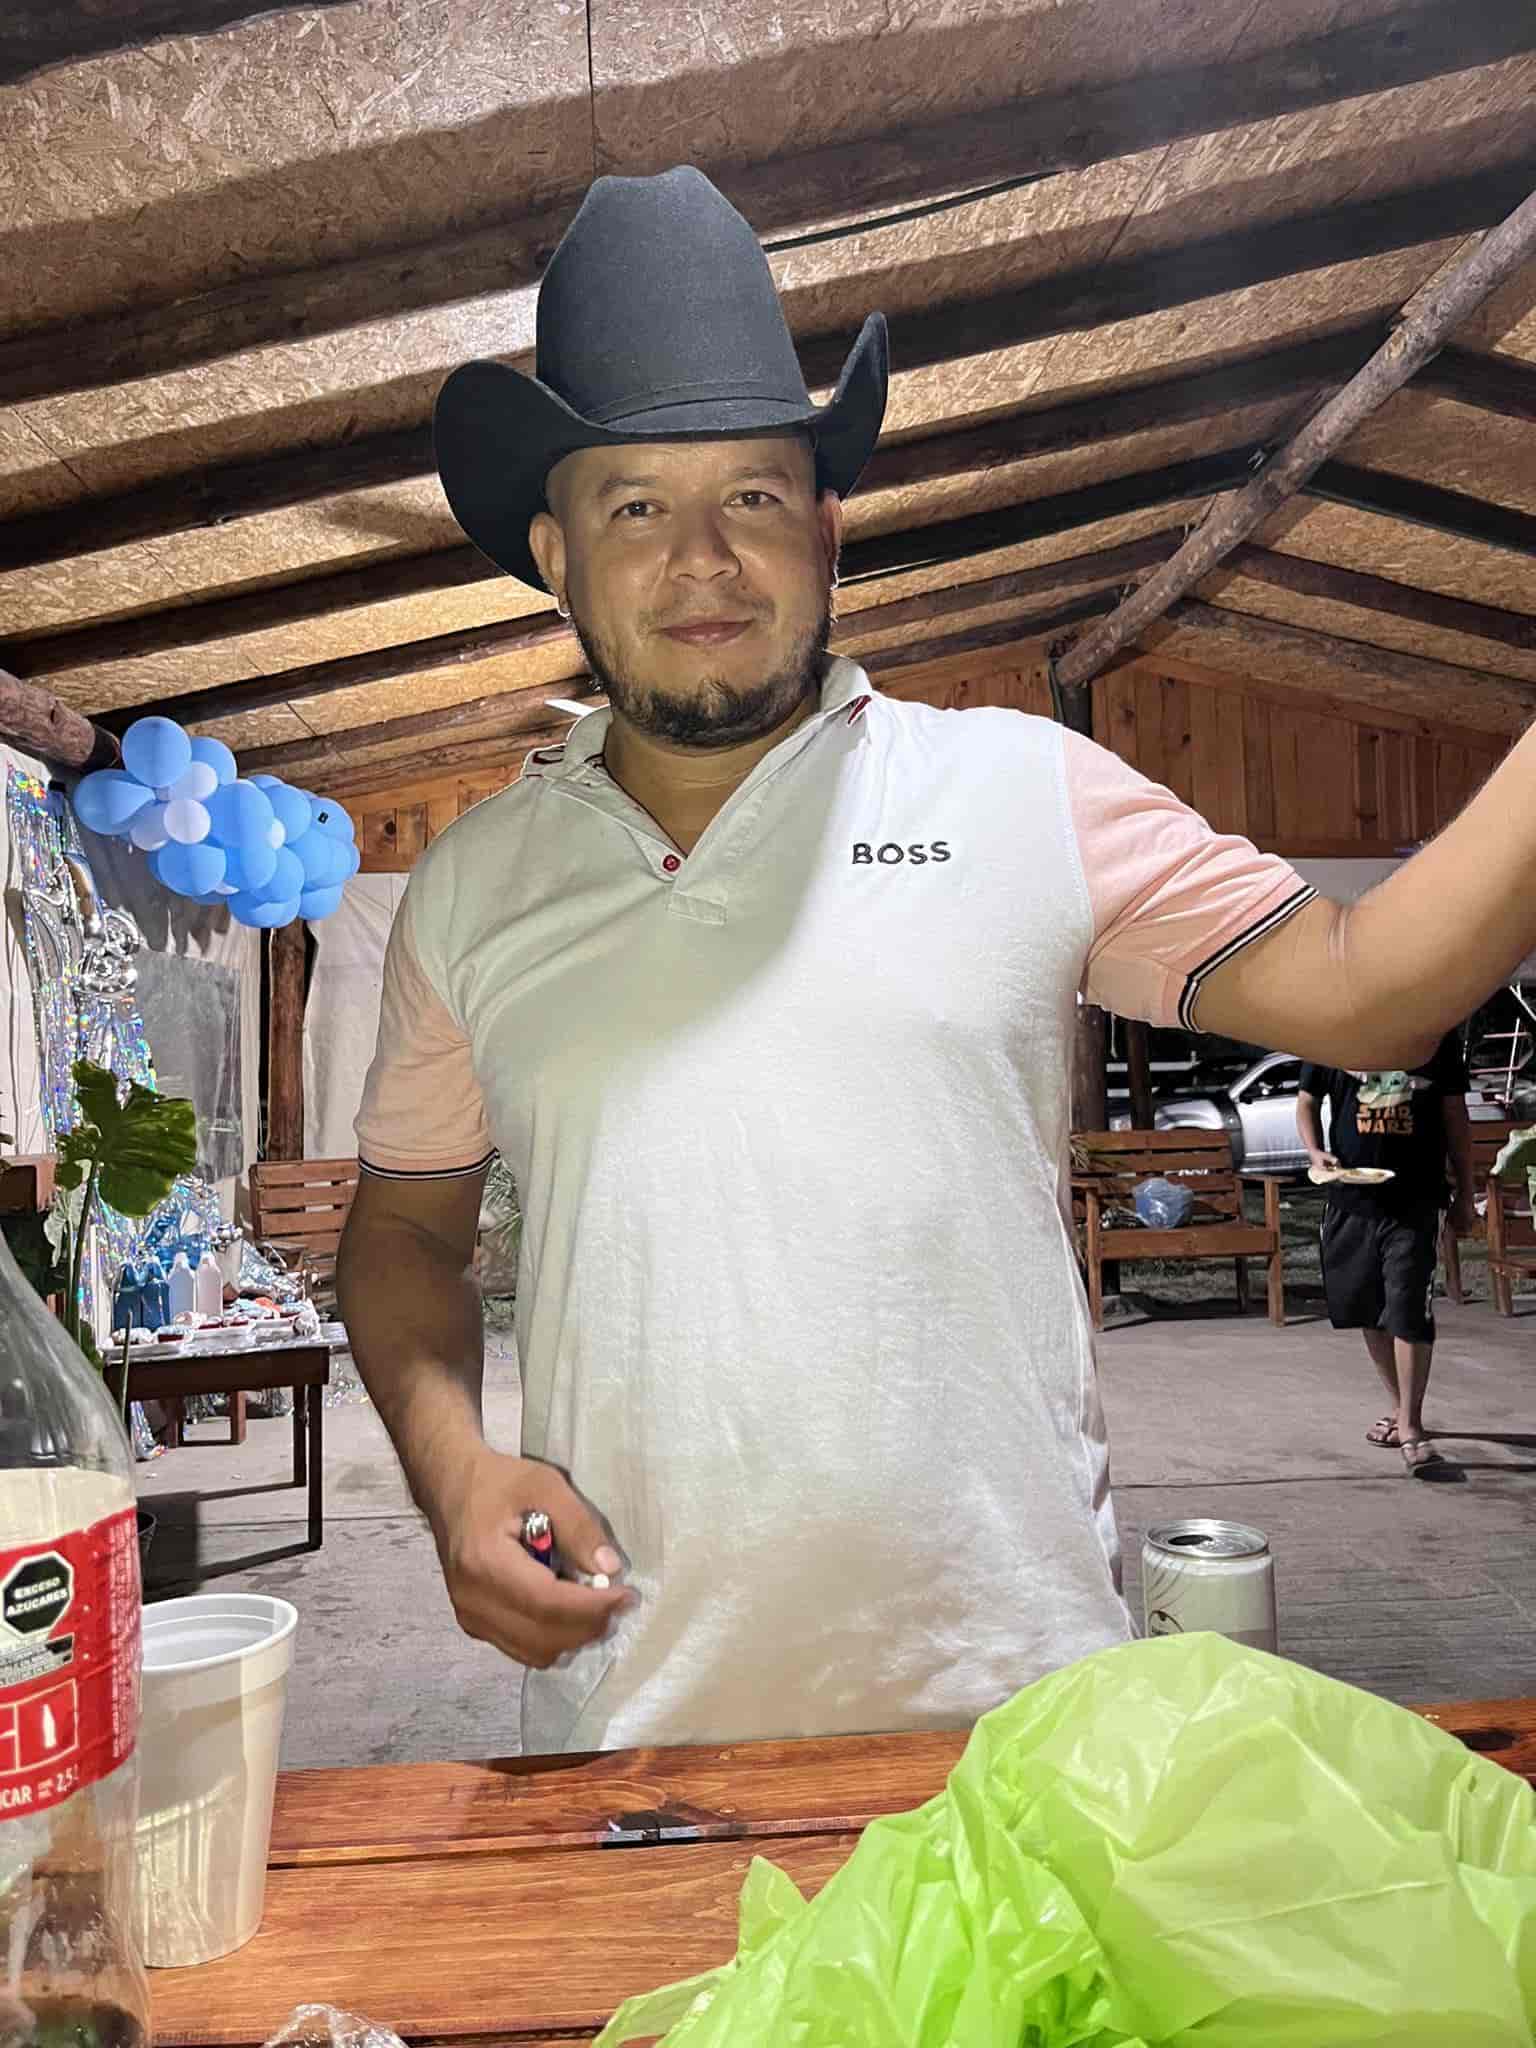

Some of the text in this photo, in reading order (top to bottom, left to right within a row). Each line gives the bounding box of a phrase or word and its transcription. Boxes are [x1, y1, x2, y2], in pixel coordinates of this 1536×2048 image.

[852, 840, 952, 865] BOSS
[1356, 1102, 1413, 1119] STAR
[1356, 1118, 1413, 1135] WARS
[14, 1576, 61, 1599] EXCESO
[0, 1784, 33, 1810] CAR
